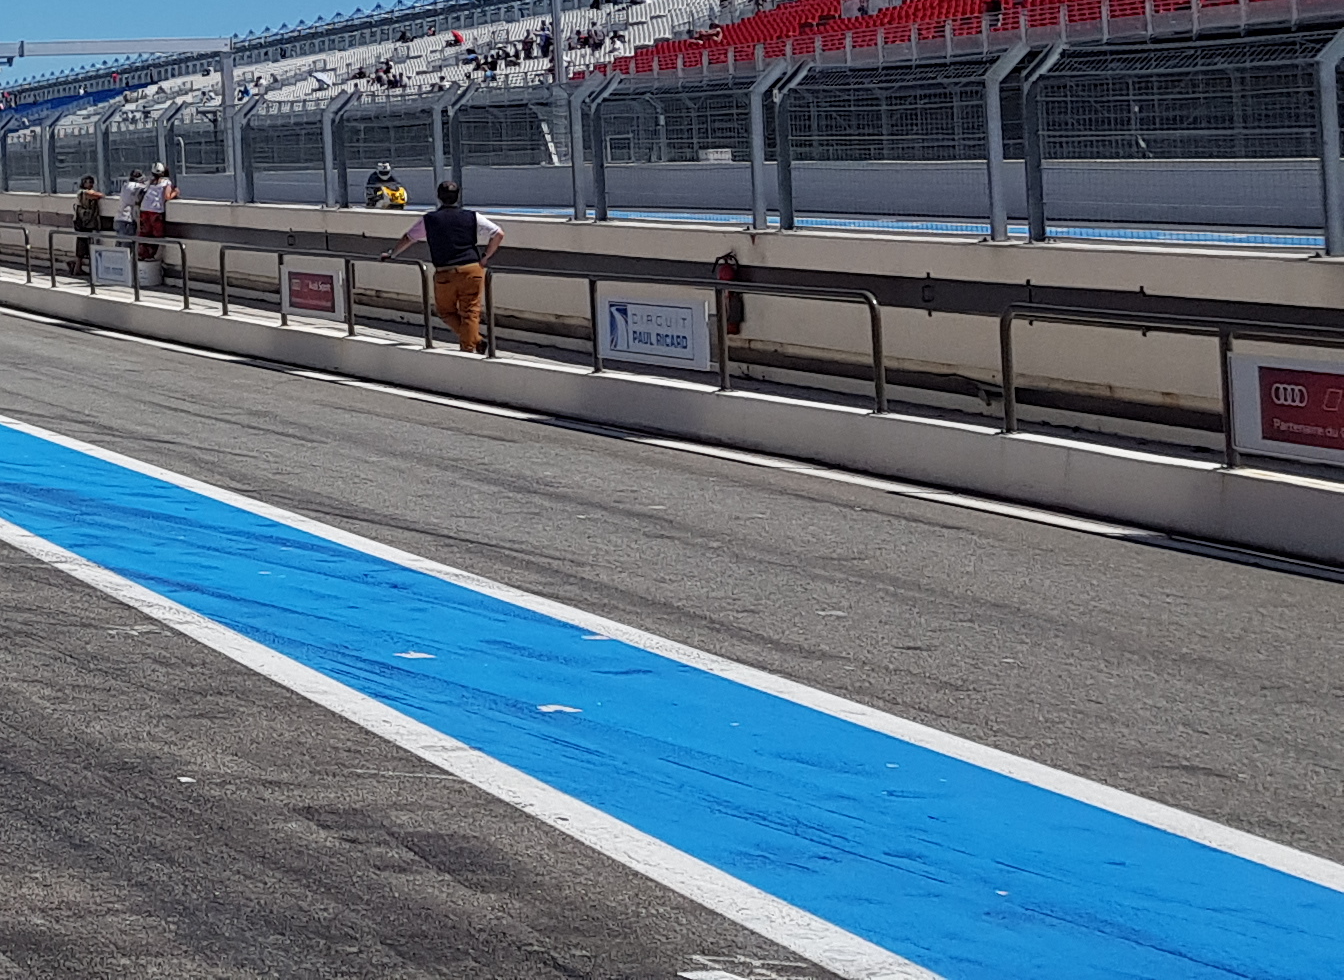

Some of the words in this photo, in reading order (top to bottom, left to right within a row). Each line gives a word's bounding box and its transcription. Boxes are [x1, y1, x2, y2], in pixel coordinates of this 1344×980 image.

[632, 313, 687, 329] CIRCUIT
[632, 330, 654, 346] PAUL
[656, 332, 688, 349] RICARD
